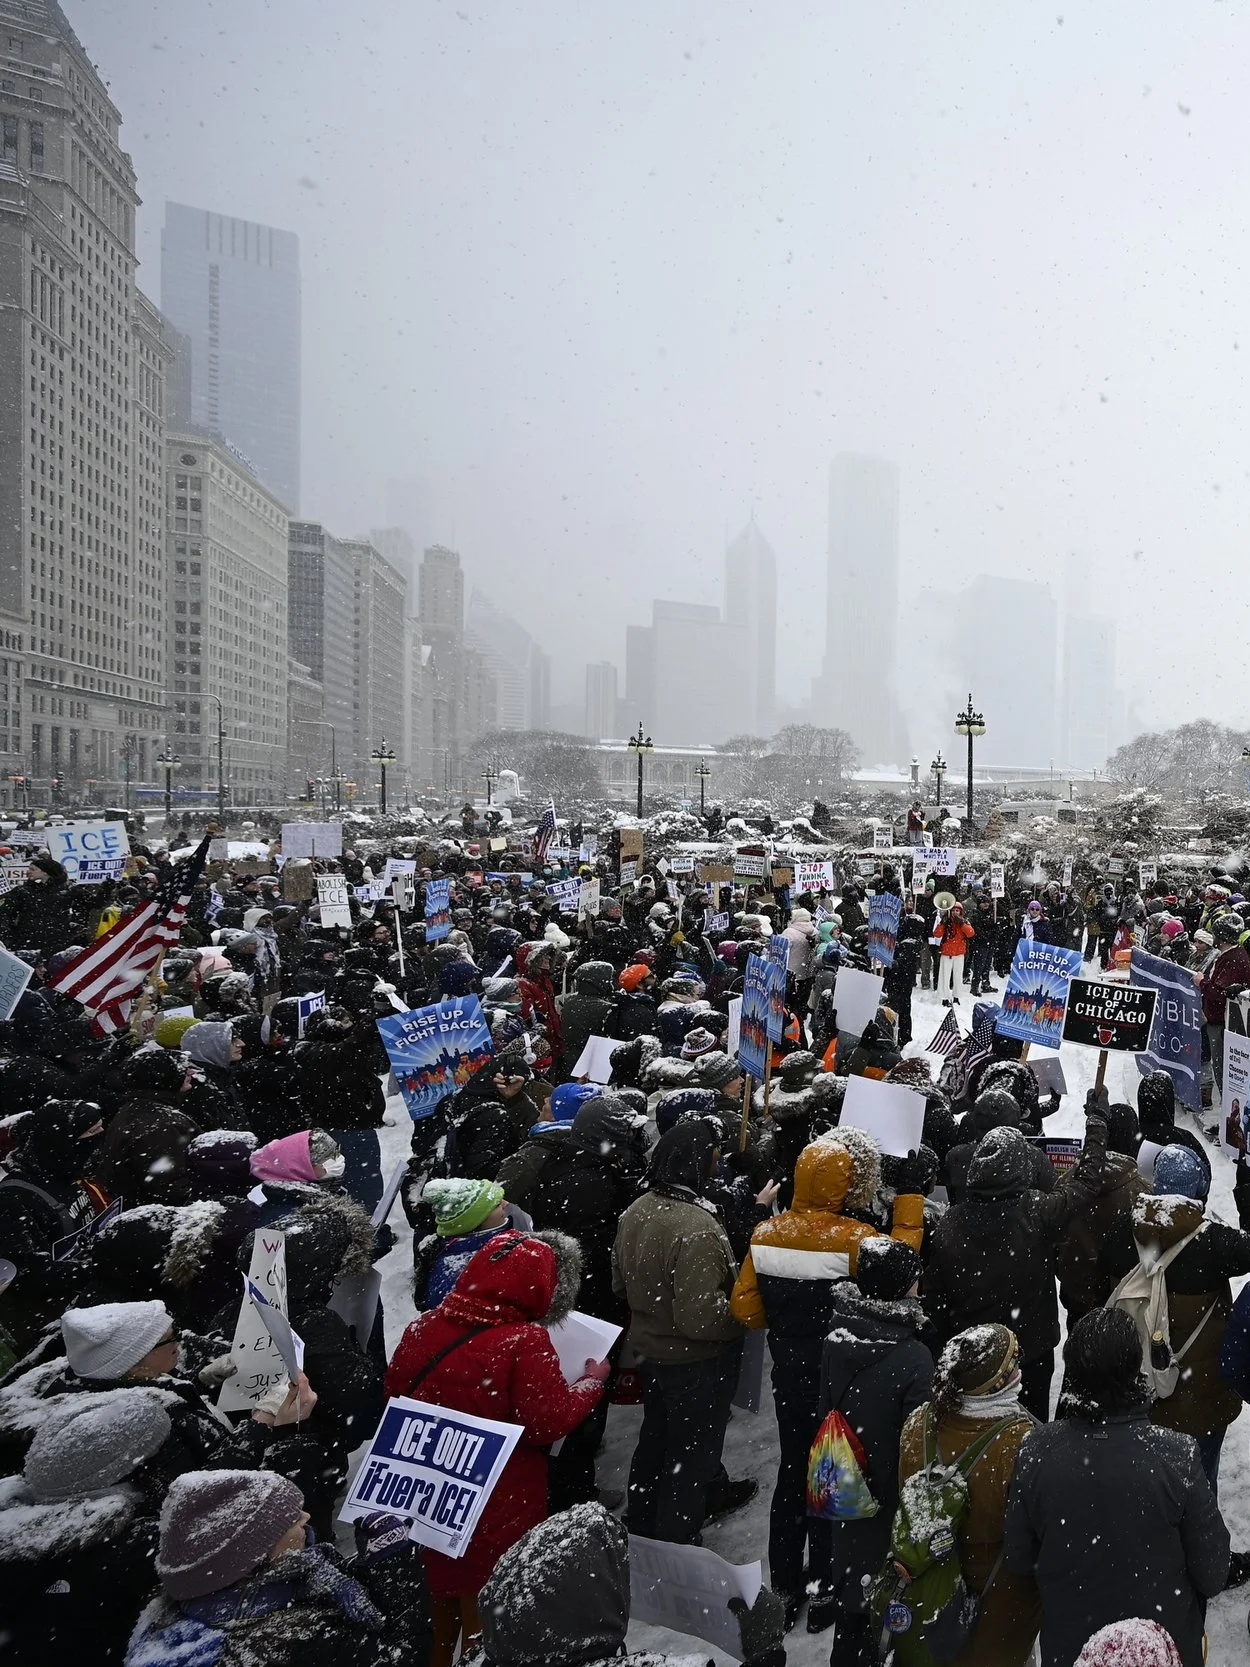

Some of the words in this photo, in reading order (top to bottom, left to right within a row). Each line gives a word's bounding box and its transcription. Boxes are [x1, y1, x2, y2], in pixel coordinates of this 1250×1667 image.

[59, 828, 119, 853] ICE
[87, 861, 104, 870] ICE
[800, 864, 824, 872] STOP
[798, 872, 826, 881] FUNDING
[317, 878, 347, 890] ABOLISH
[552, 884, 564, 893] ICE
[802, 880, 831, 890] MURDER
[320, 890, 345, 904] ICE
[1018, 961, 1046, 970] FIGHT
[1029, 951, 1051, 961] RISE
[1053, 956, 1069, 967] UP
[1086, 984, 1111, 999] ICE
[1112, 989, 1142, 1004] OUT
[1105, 1000, 1119, 1008] OF
[1075, 1002, 1146, 1024] CHICAGO
[401, 1014, 438, 1033] RISE
[441, 1010, 464, 1021] UP
[395, 1026, 436, 1049] FIGHT
[439, 1020, 482, 1033] BACK
[1228, 1064, 1243, 1075] Choose
[391, 1416, 438, 1462] ICE
[432, 1426, 486, 1477] OUT!
[431, 1481, 478, 1532] ICE!
